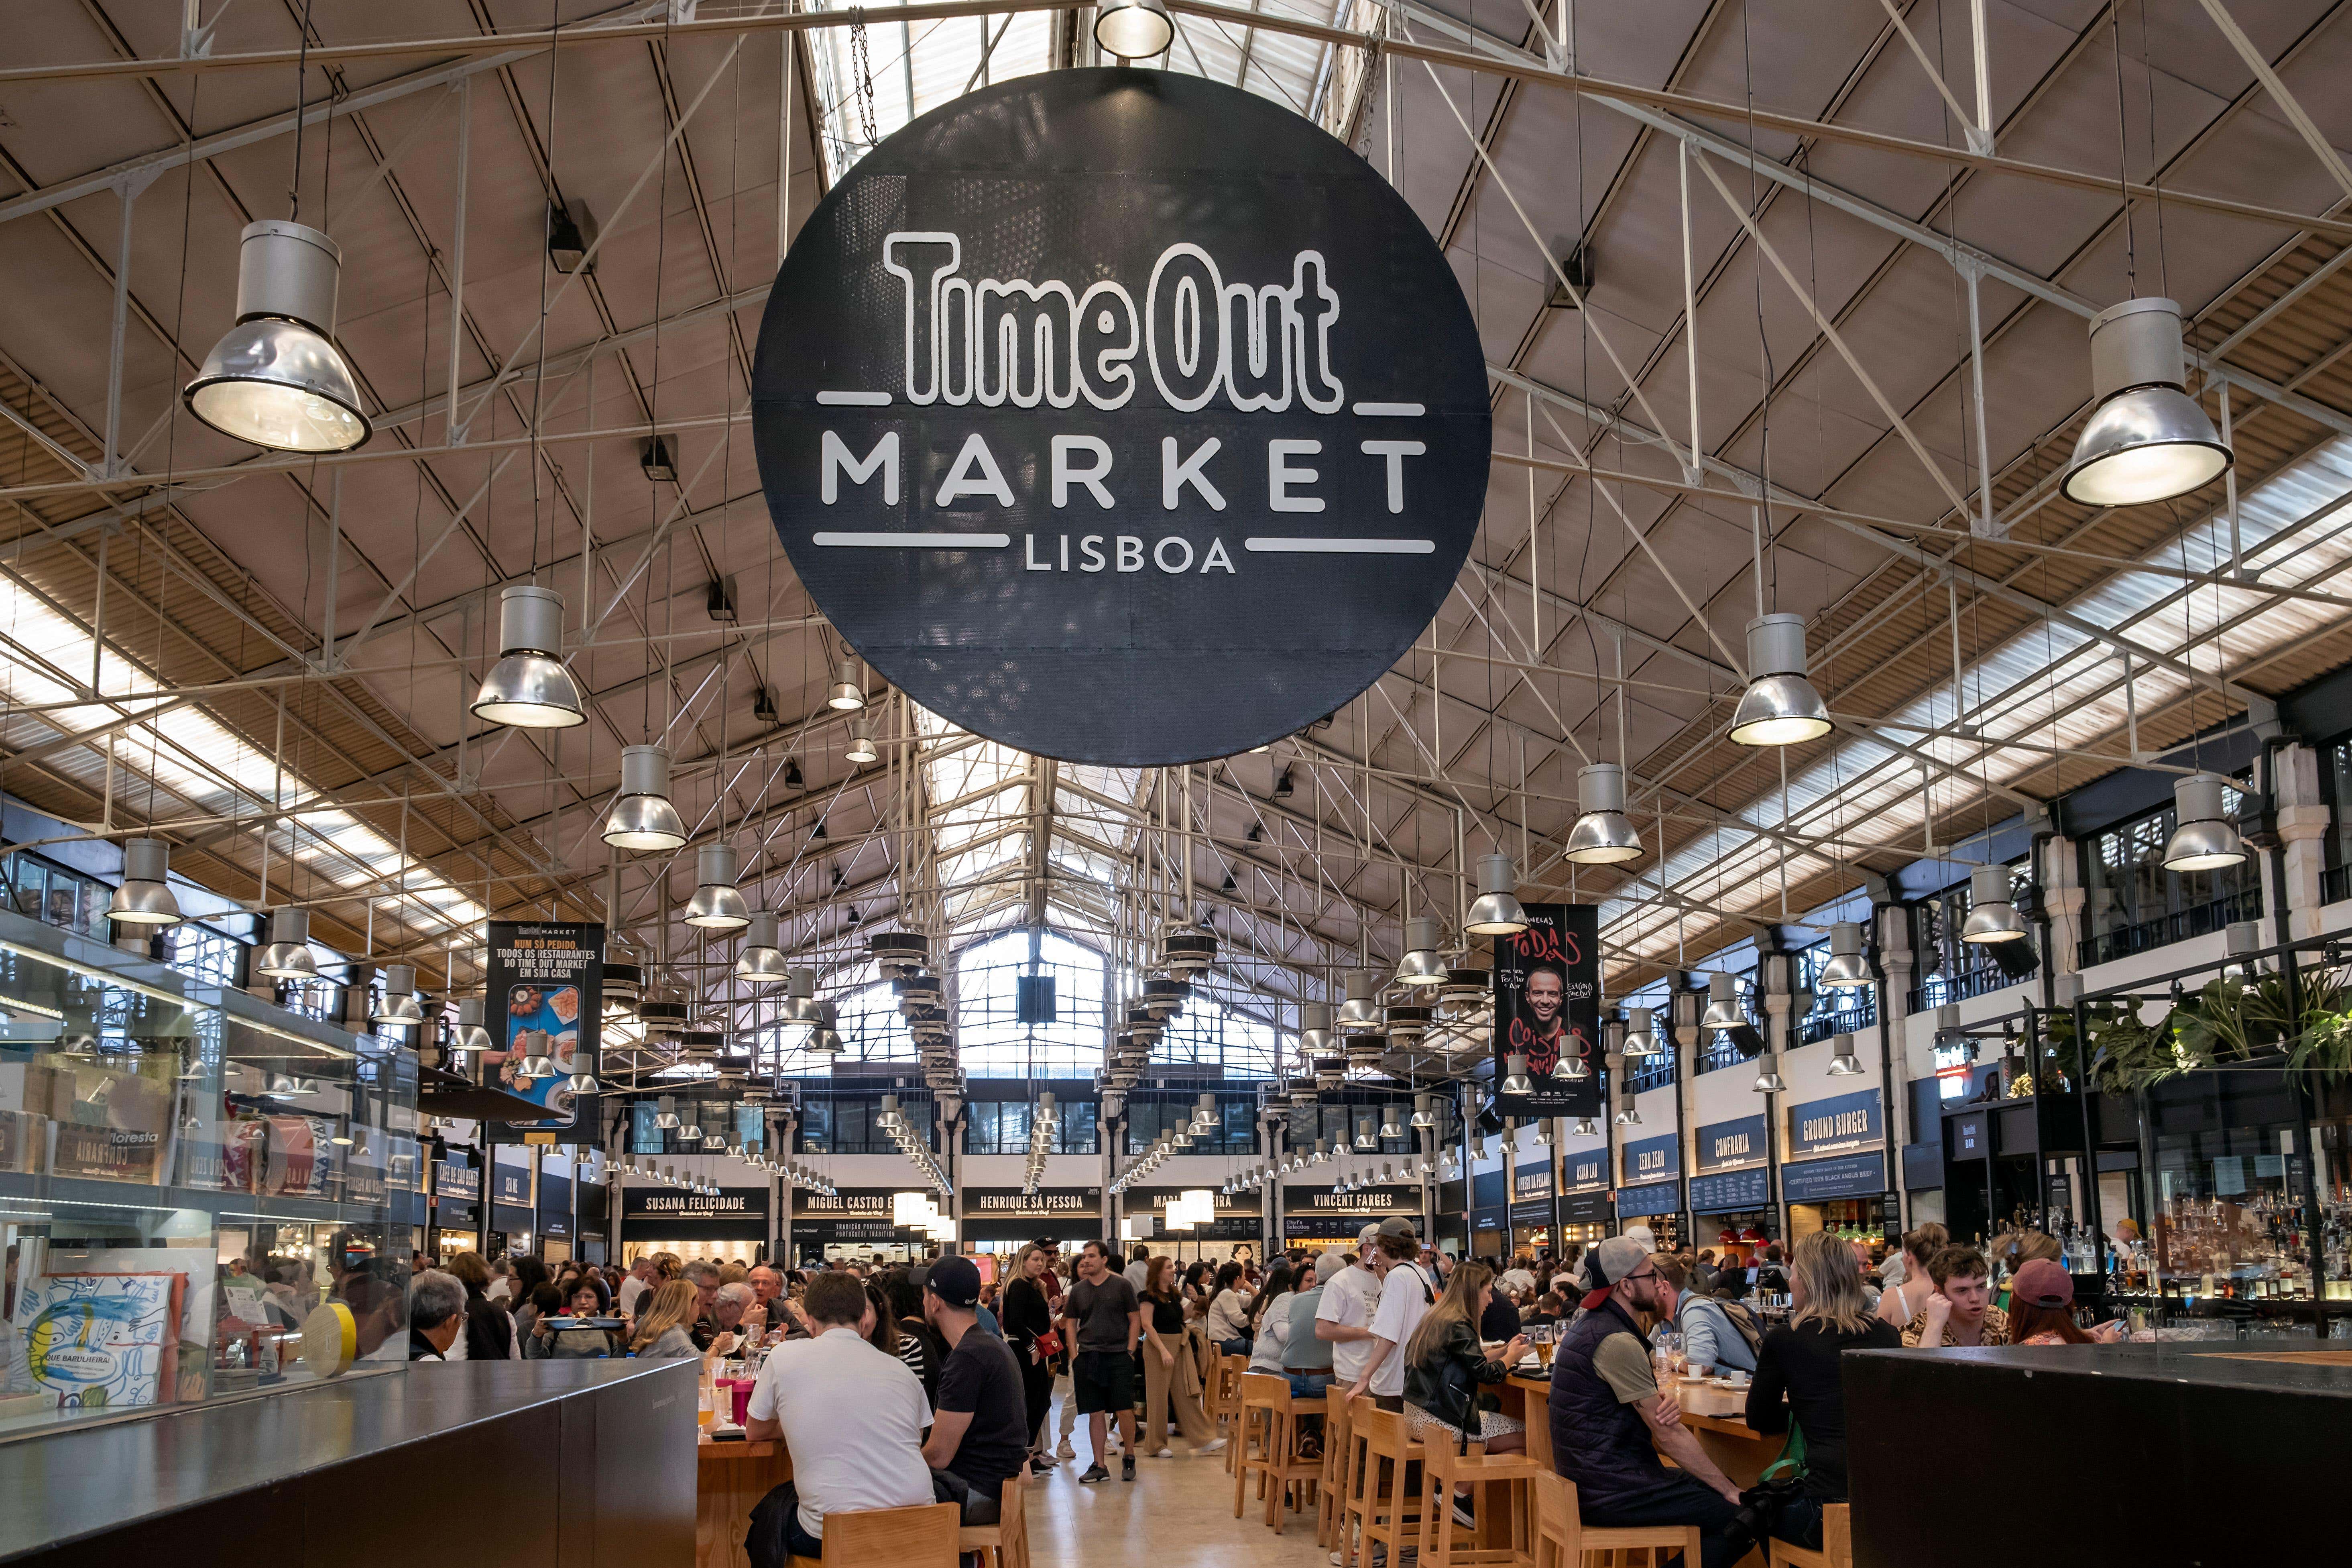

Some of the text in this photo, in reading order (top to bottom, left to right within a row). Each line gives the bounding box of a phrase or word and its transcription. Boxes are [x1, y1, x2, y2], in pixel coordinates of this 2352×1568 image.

[821, 430, 1426, 514] MARKET
[1025, 535, 1236, 575] LISBOA
[1525, 917, 1553, 925] ANELAS
[515, 938, 578, 950] NUM SÓ PEDIDO,
[496, 949, 595, 960] TODOS OS RESTAURANTES
[504, 958, 515, 968] DO
[517, 959, 536, 968] TIME
[556, 960, 588, 969] MARKET
[520, 968, 571, 978] EM SUA CASA
[1804, 1109, 1868, 1141] GROUND BURGER
[1715, 1133, 1750, 1157] CONFRARIA
[1639, 1149, 1664, 1170] ZERO ZERO
[1577, 1164, 1589, 1180] ASIAN
[1790, 1176, 1812, 1185] CERTIFIED
[646, 1197, 745, 1210] SUSANA FELICIDADE
[808, 1196, 893, 1209] MIGUEL CASTRO E
[980, 1194, 1082, 1209] HENRIQUE SÁ PESSOA
[1314, 1194, 1392, 1206] VINCENT FARGES
[62, 1355, 110, 1363] BARULHEIRA!
